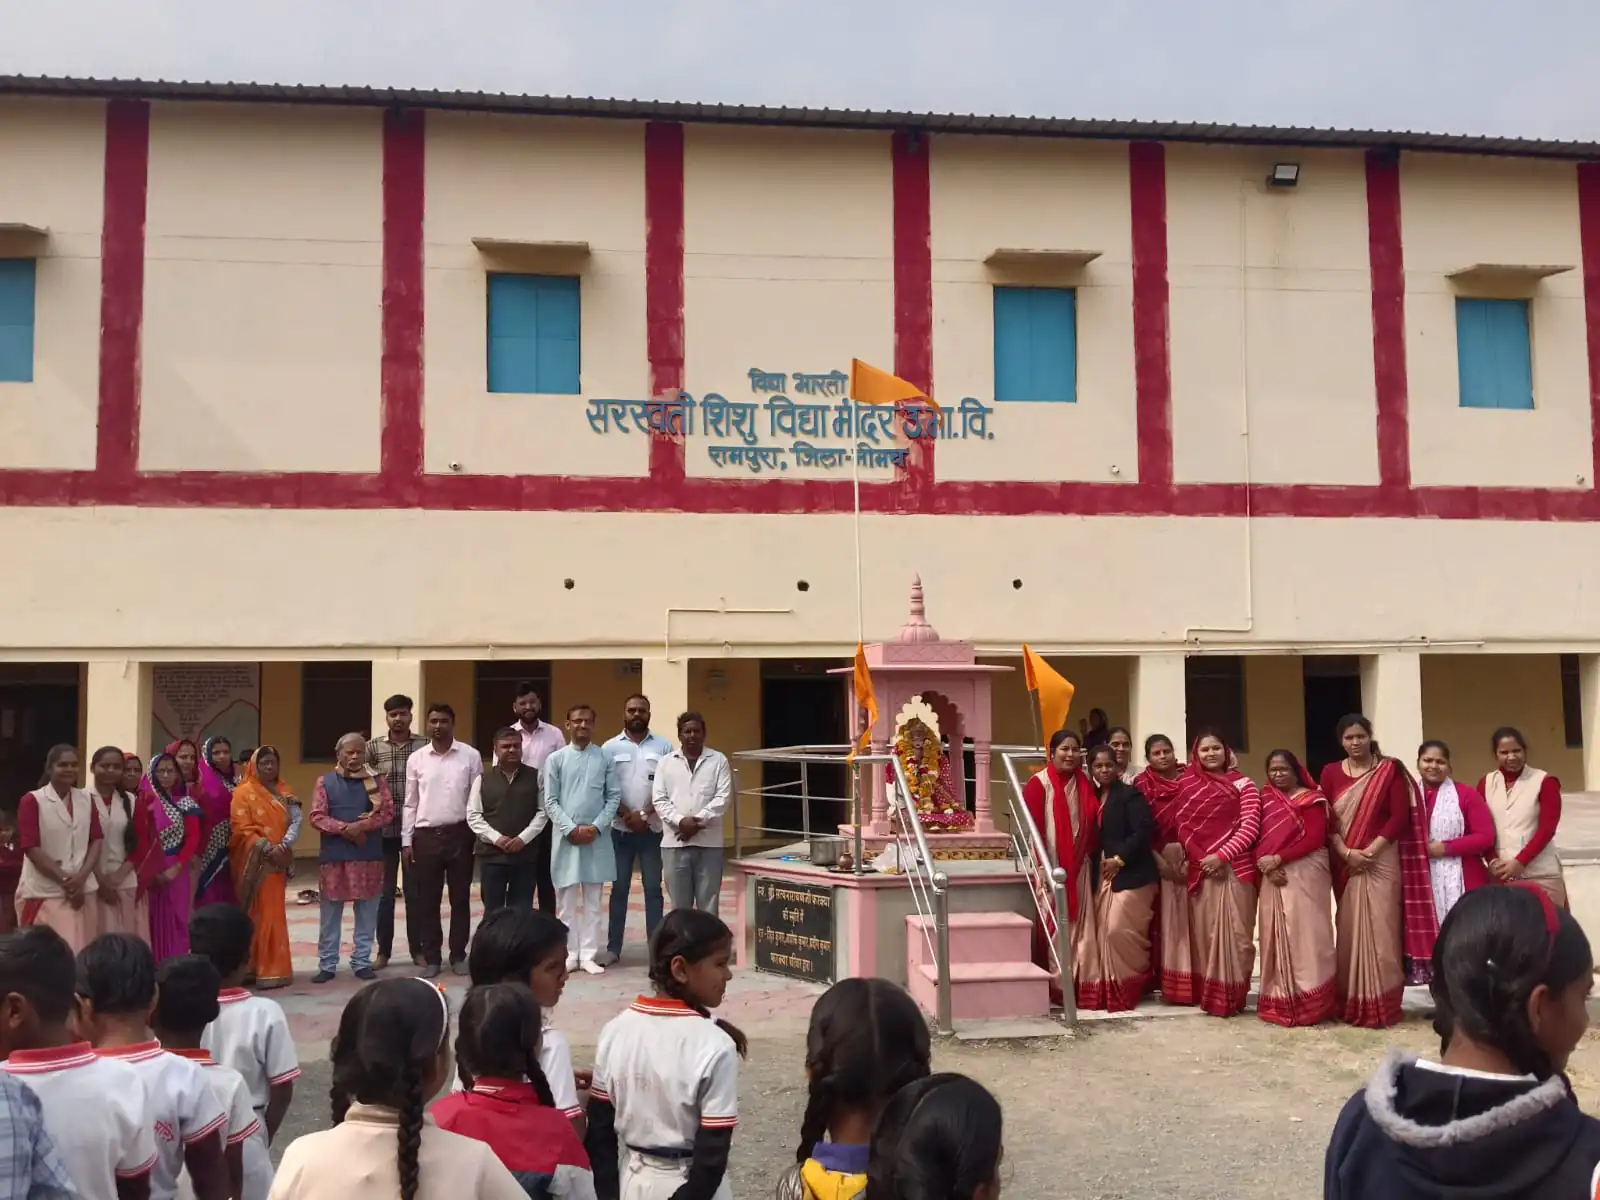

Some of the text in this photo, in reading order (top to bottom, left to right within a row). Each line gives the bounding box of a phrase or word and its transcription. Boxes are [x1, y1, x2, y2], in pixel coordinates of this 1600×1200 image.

[748, 367, 848, 397] विद्या भारती
[586, 392, 696, 435] सरस्वती
[700, 393, 759, 445] शिशु
[763, 395, 830, 438] विद्या
